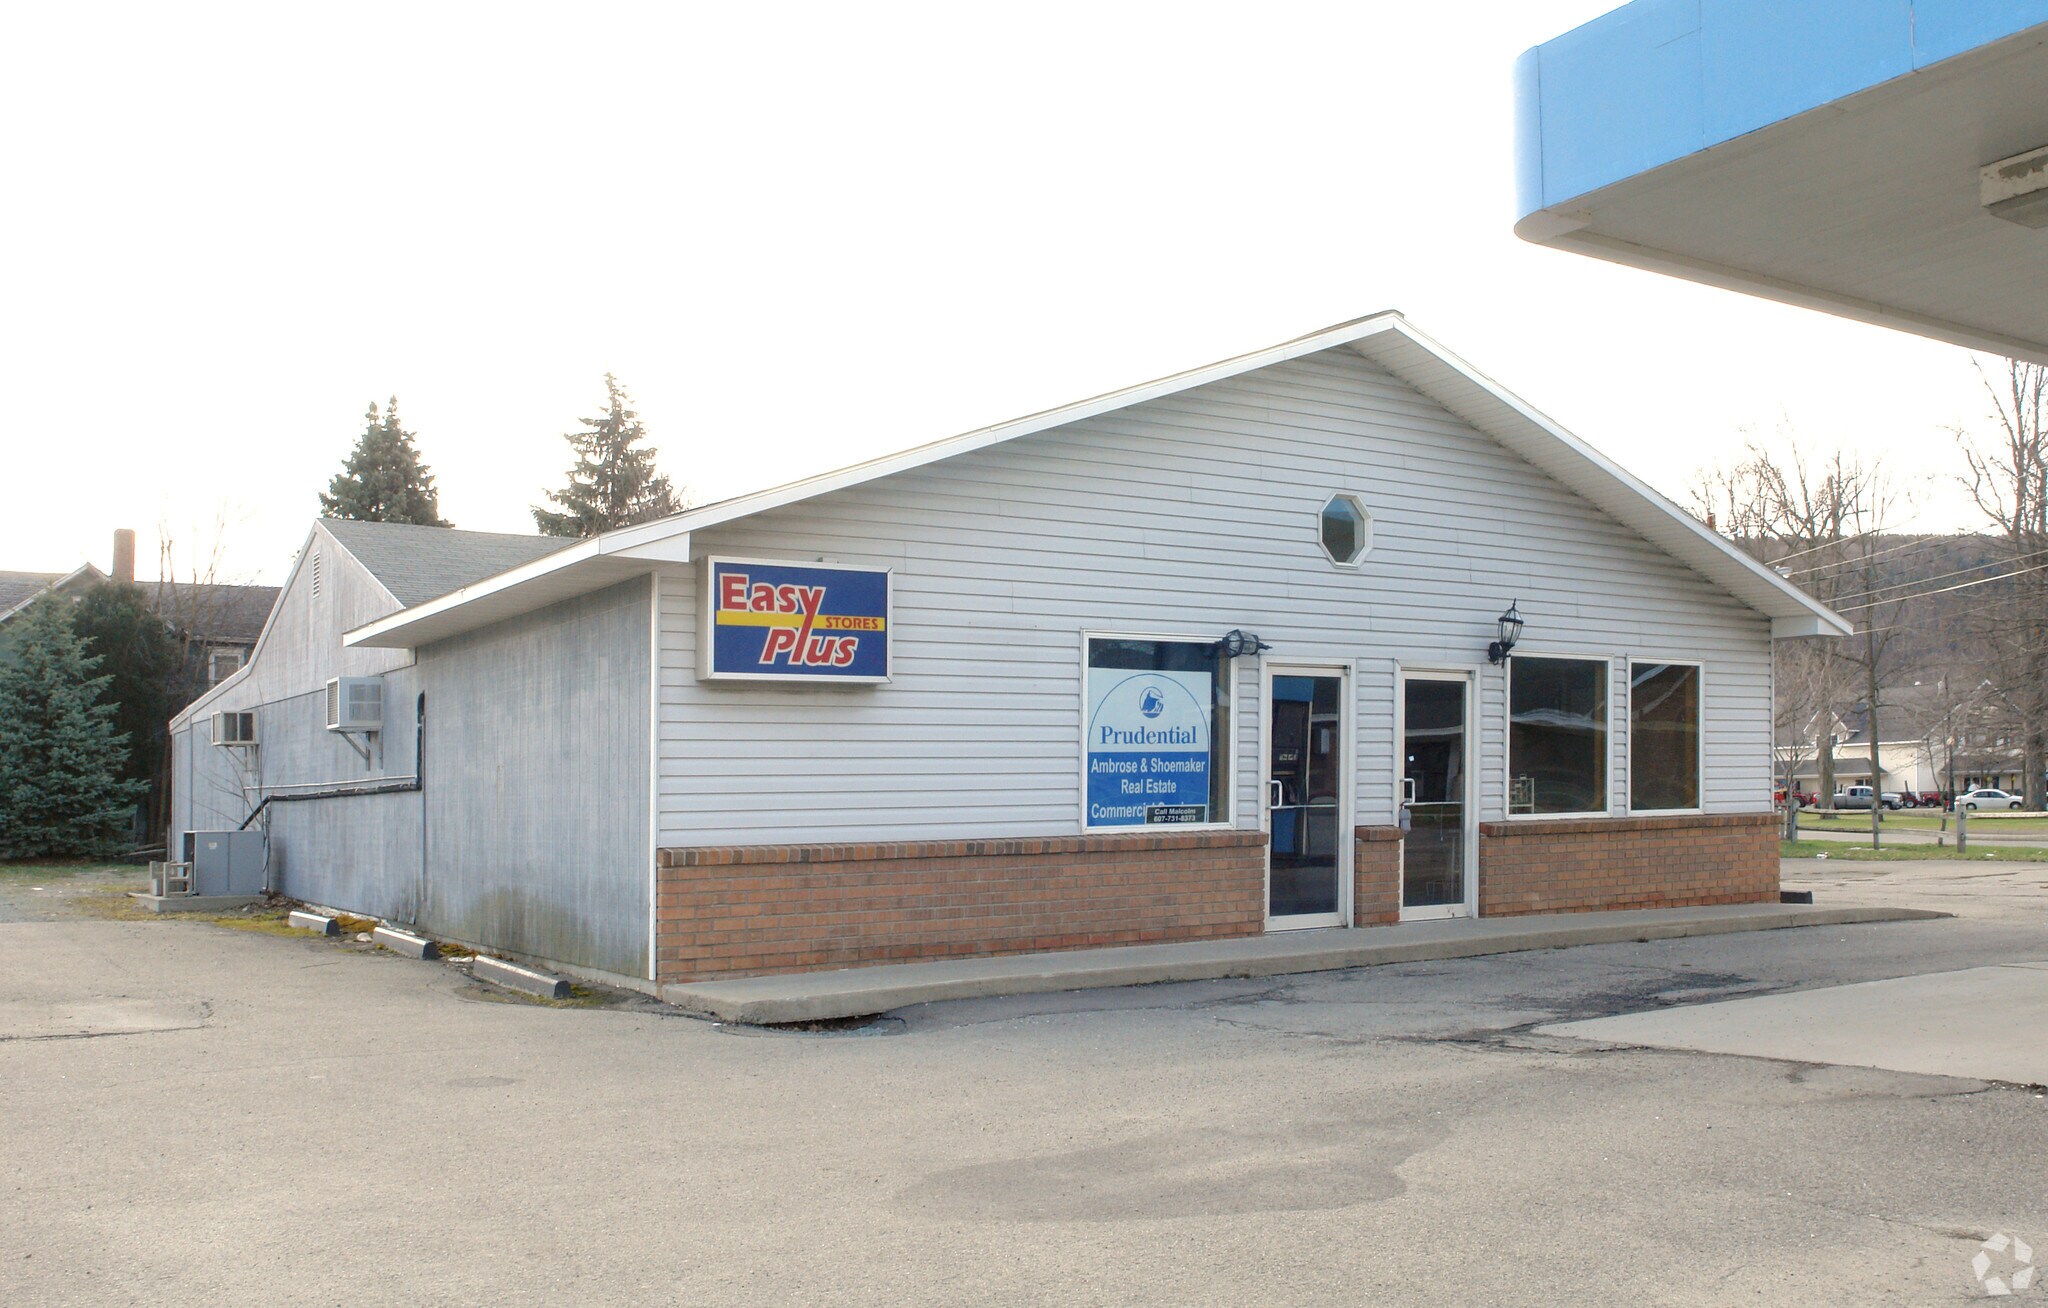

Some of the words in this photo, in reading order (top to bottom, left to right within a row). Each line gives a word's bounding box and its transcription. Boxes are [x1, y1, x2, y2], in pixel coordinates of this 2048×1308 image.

[720, 574, 826, 627] Easy
[825, 616, 879, 630] STORES
[759, 627, 858, 667] Plus
[1100, 725, 1197, 745] Prudential
[1091, 758, 1138, 773] Ambrose
[1140, 757, 1148, 772] &
[1150, 757, 1205, 773] Shoemaker
[1121, 779, 1143, 794] Real
[1146, 778, 1177, 794] Estate
[1091, 802, 1147, 818] Commerci
